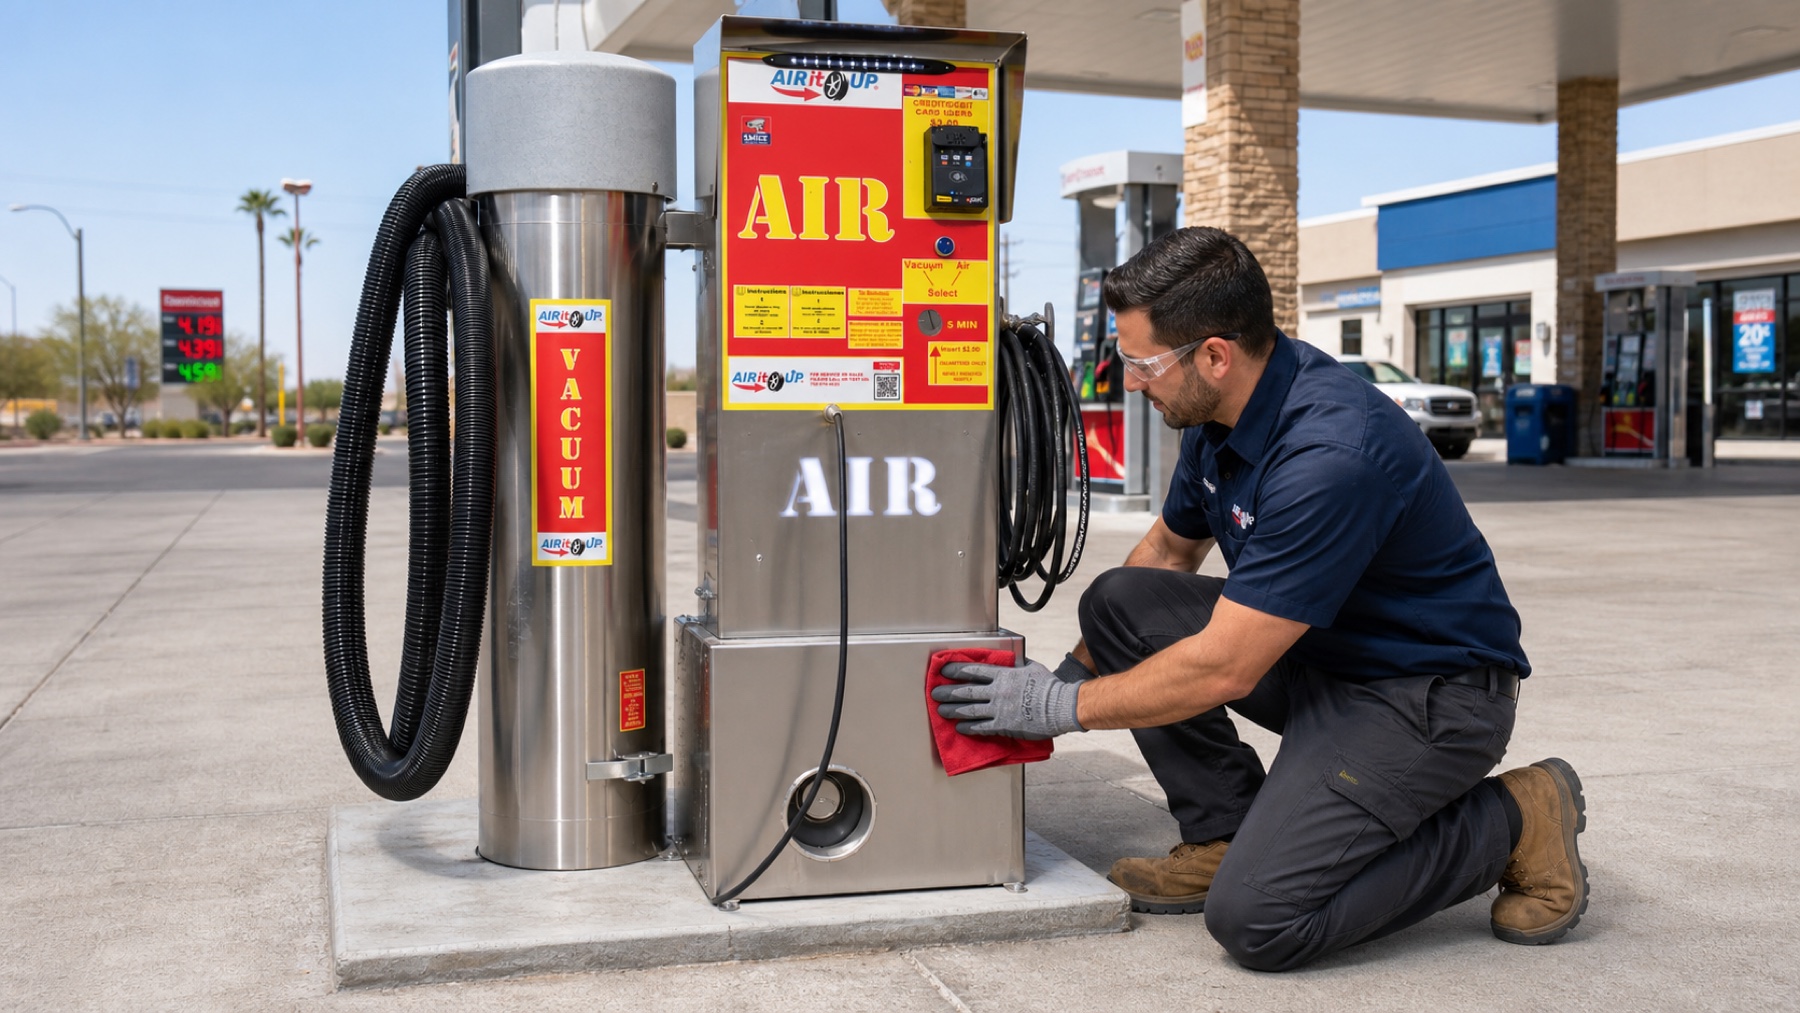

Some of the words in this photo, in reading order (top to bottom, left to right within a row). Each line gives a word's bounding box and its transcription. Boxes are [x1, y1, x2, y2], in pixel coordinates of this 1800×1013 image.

[737, 174, 896, 243] AIR
[903, 260, 943, 271] Vacuum
[956, 261, 971, 270] Air
[927, 288, 958, 298] Select
[956, 320, 978, 329] MIN
[559, 348, 585, 519] VACUUM
[778, 456, 942, 517] AIR
